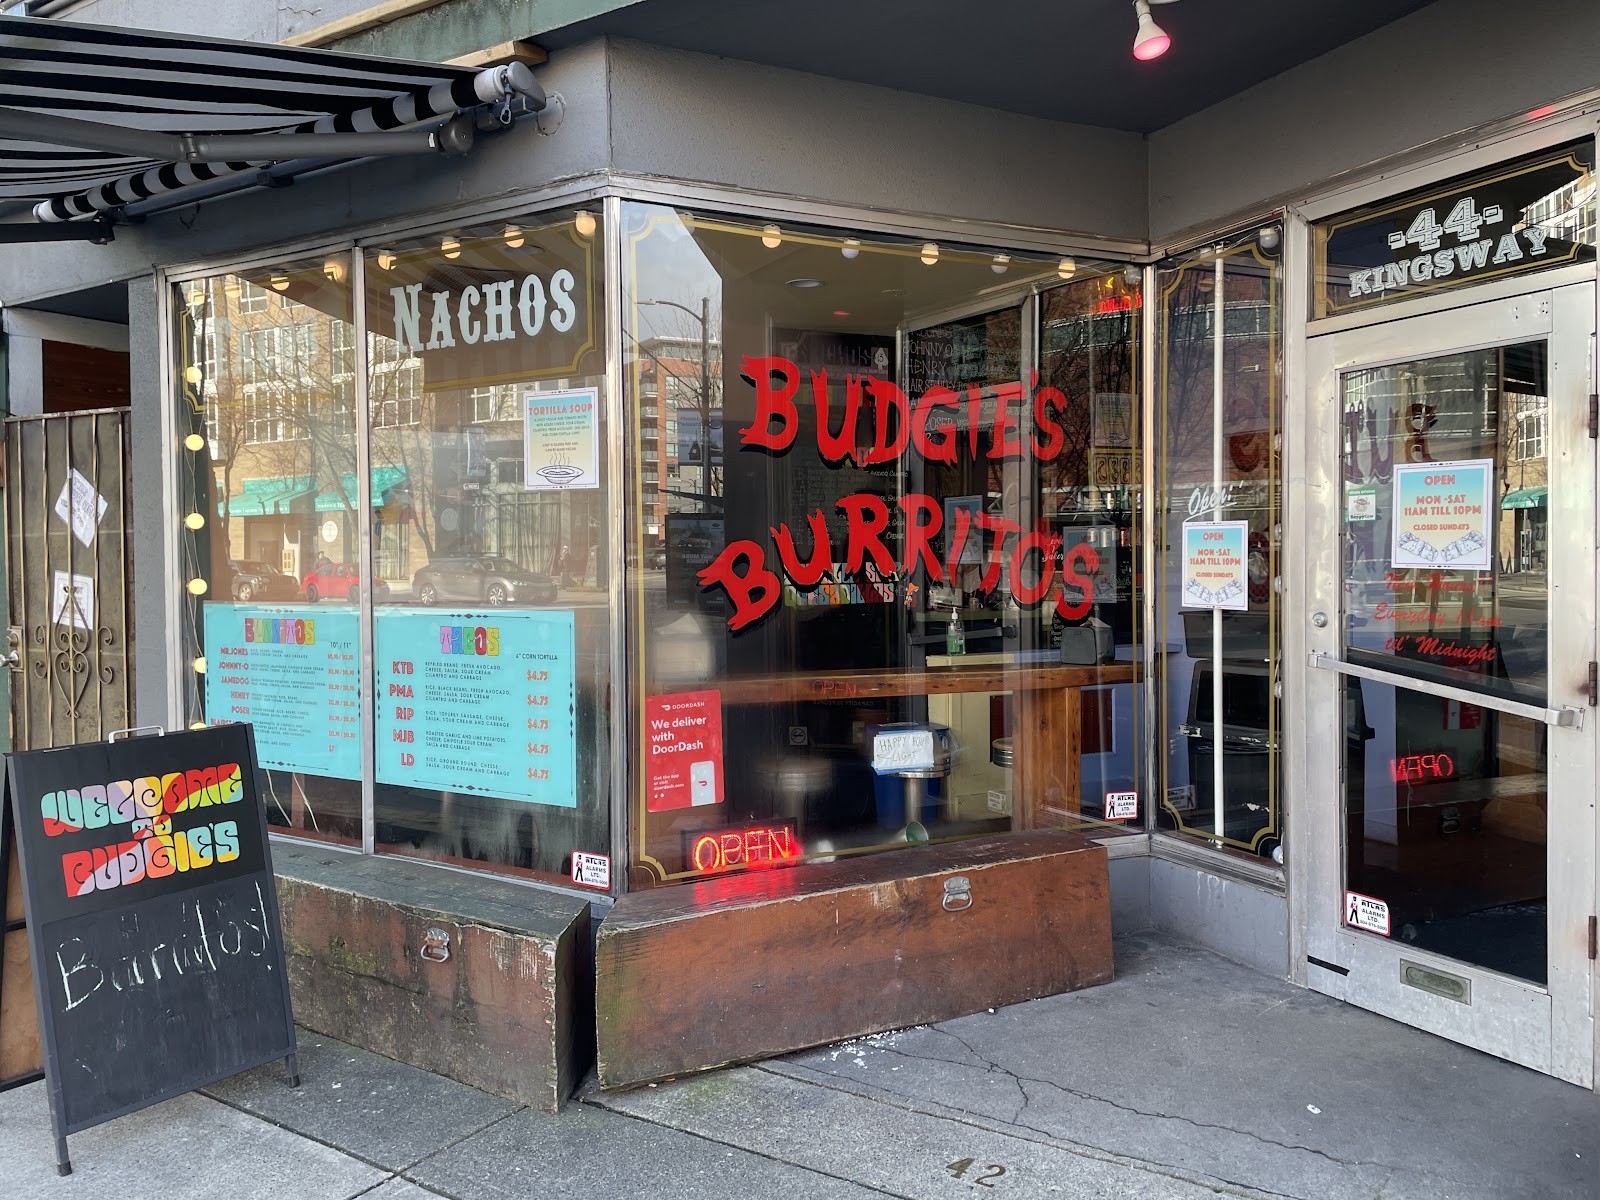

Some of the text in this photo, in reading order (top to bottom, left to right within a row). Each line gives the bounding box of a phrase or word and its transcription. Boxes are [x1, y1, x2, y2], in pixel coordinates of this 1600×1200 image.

[1349, 225, 1551, 297] KINGSWAY
[390, 269, 576, 353] NACHOS
[528, 403, 592, 416] TORTILLA SOUP
[738, 354, 1069, 467] BUDGIE'S
[1424, 475, 1456, 486] OPEN
[1416, 495, 1441, 505] MON
[1404, 505, 1482, 516] 11AM TILL 10PM
[1439, 523, 1470, 531] SUNDAYS
[1203, 532, 1224, 541] OPEN
[697, 493, 1100, 633] BURRITOS
[1190, 558, 1241, 566] 11AM TILL 10PM
[244, 617, 315, 645] BURRITOS
[440, 626, 500, 656] TACOS
[1416, 635, 1497, 665] Midnight
[392, 661, 414, 674] KTB
[526, 670, 548, 681] $4.75
[230, 690, 250, 700] HENRY
[390, 684, 414, 698] PMA
[527, 694, 549, 706] $4.75
[231, 706, 250, 714] POSER
[396, 706, 414, 720] RIP
[527, 718, 549, 730] $4.75
[651, 716, 707, 730] We deliver
[392, 728, 414, 744] MJB
[652, 731, 675, 742] with
[528, 742, 549, 754] $4.75
[652, 740, 704, 755] DoorDash
[880, 736, 906, 752] HAPPY
[400, 752, 414, 766] LD
[892, 751, 916, 762] LIGHT
[528, 768, 550, 780] $4.75
[41, 763, 244, 837] WELCOME
[132, 814, 173, 840] TO
[694, 826, 789, 872] OPEN
[62, 820, 241, 898] BUDGIE'S
[586, 856, 606, 866] ATLAS
[586, 866, 606, 874] ALARMS
[1361, 899, 1386, 912] ATLAS
[1362, 908, 1386, 919] ALARMS
[1368, 916, 1380, 924] LTD.
[946, 1158, 1006, 1188] 42
